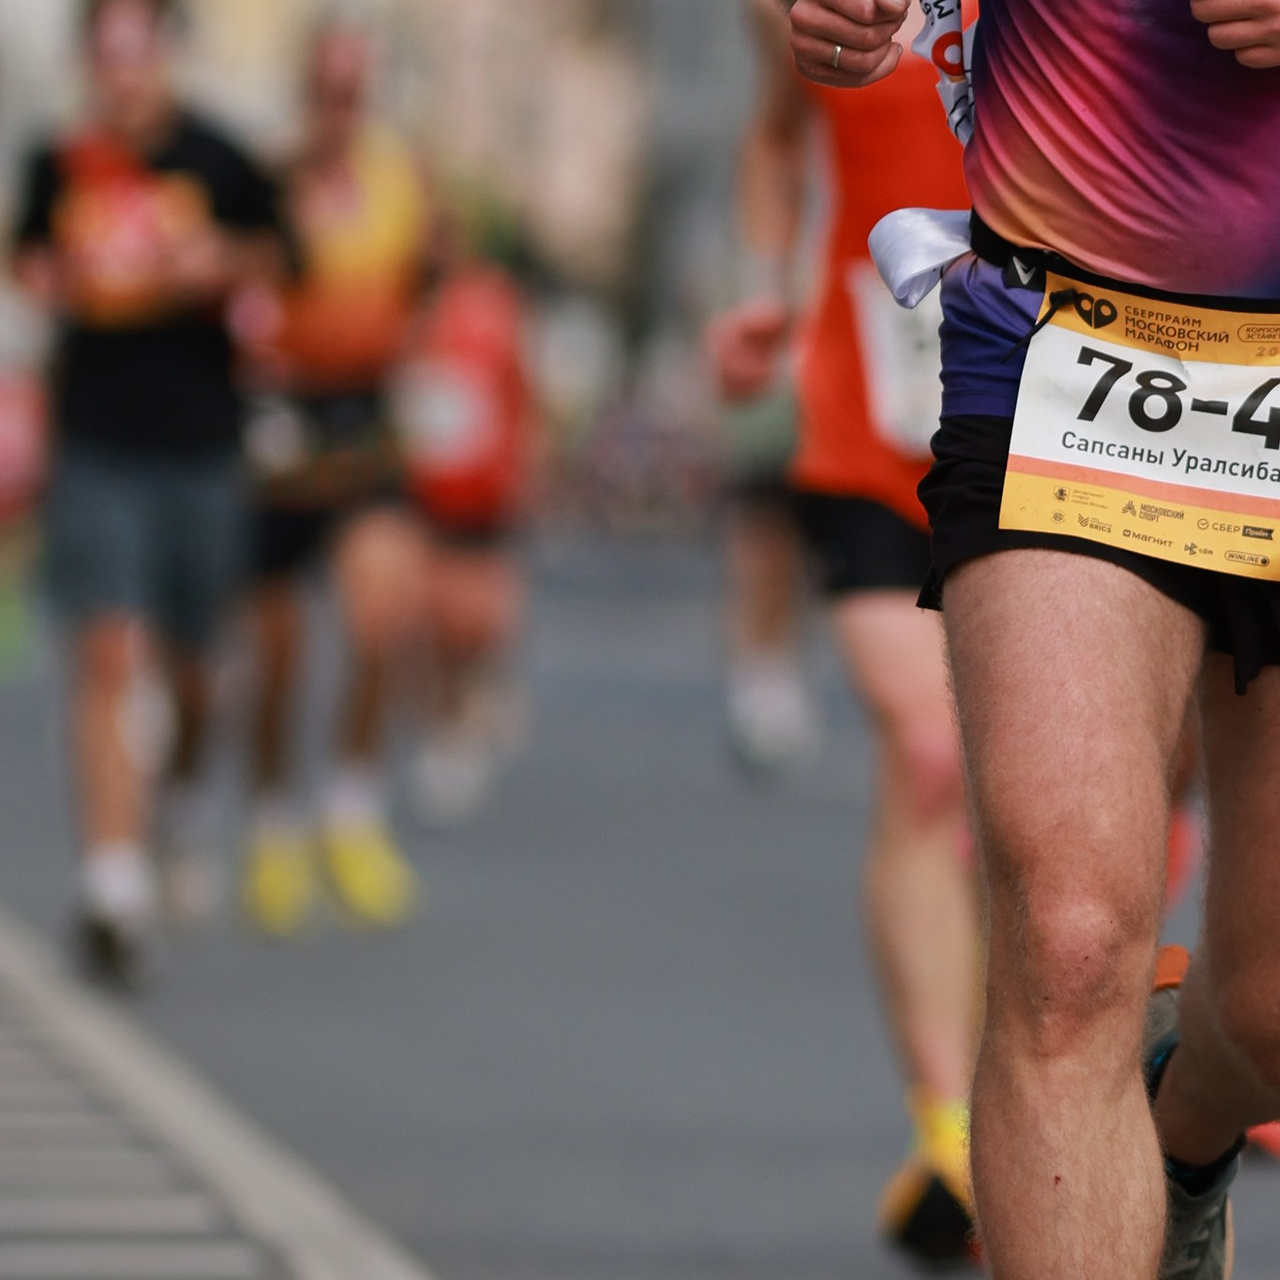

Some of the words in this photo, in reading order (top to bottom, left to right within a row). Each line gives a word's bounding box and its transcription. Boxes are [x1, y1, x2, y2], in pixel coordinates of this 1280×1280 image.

[1124, 304, 1202, 328] СБЕРПРАЙМ
[1124, 315, 1230, 344] МОСКОВСКИЙ
[1124, 326, 1200, 353] МАРАФОН
[1061, 430, 1165, 466] Сапсаны
[1088, 522, 1112, 534] BRICS
[1211, 522, 1241, 534] СБЕР
[1227, 551, 1260, 564] WINLINE
